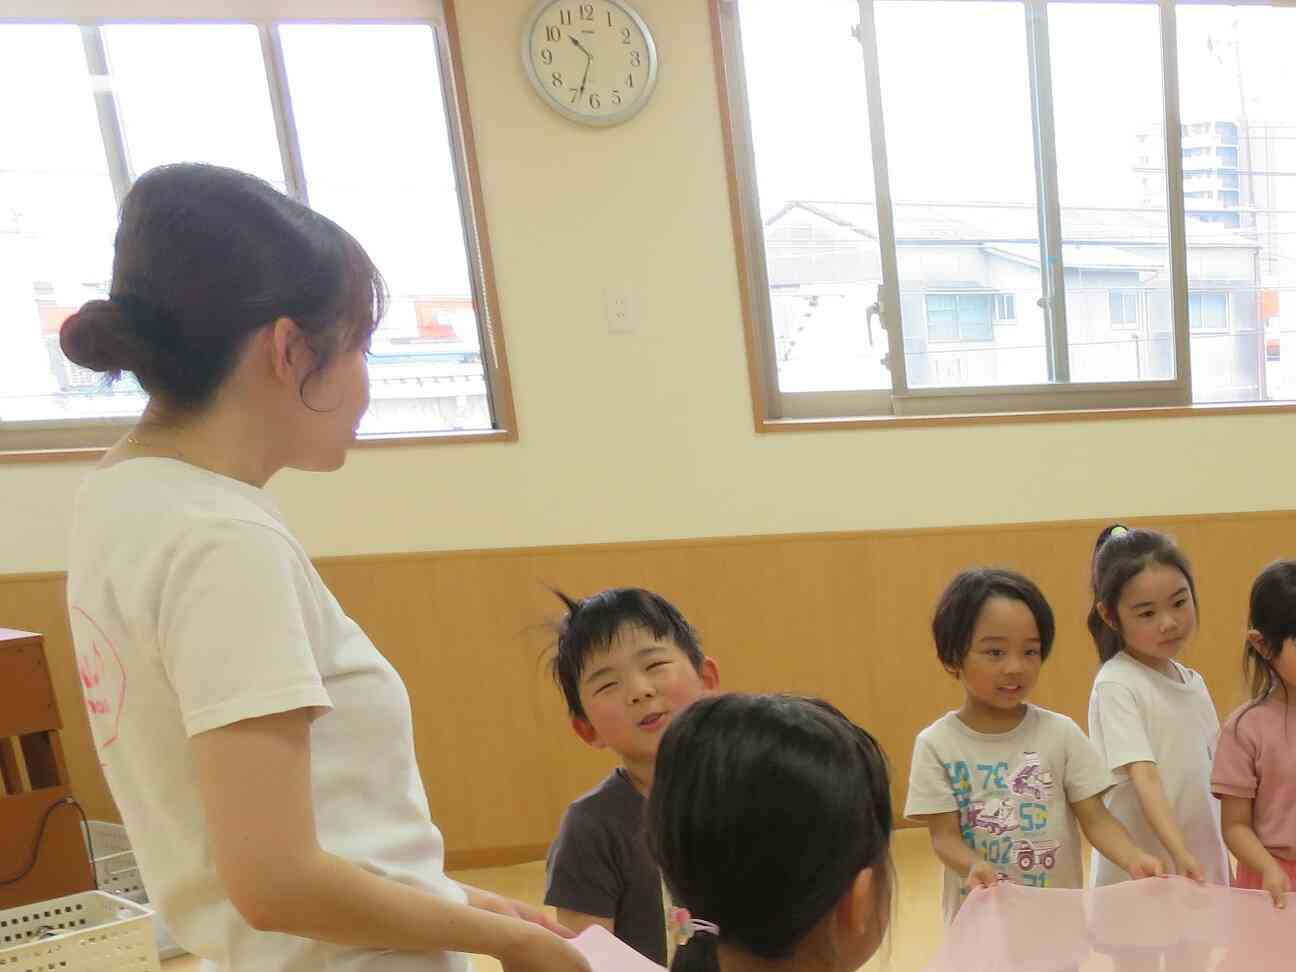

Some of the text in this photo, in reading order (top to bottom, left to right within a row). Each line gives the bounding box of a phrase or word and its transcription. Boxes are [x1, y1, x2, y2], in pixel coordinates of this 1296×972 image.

[560, 9, 571, 25] 11
[579, 5, 594, 21] 12
[607, 11, 612, 27] 1
[545, 26, 560, 42] 10
[622, 27, 631, 44] 2
[541, 49, 552, 65] 9
[630, 51, 640, 67] 3
[552, 72, 563, 88] 8
[625, 72, 634, 88] 4
[569, 88, 578, 104] 7
[589, 93, 600, 109] 6
[611, 90, 621, 105] 5
